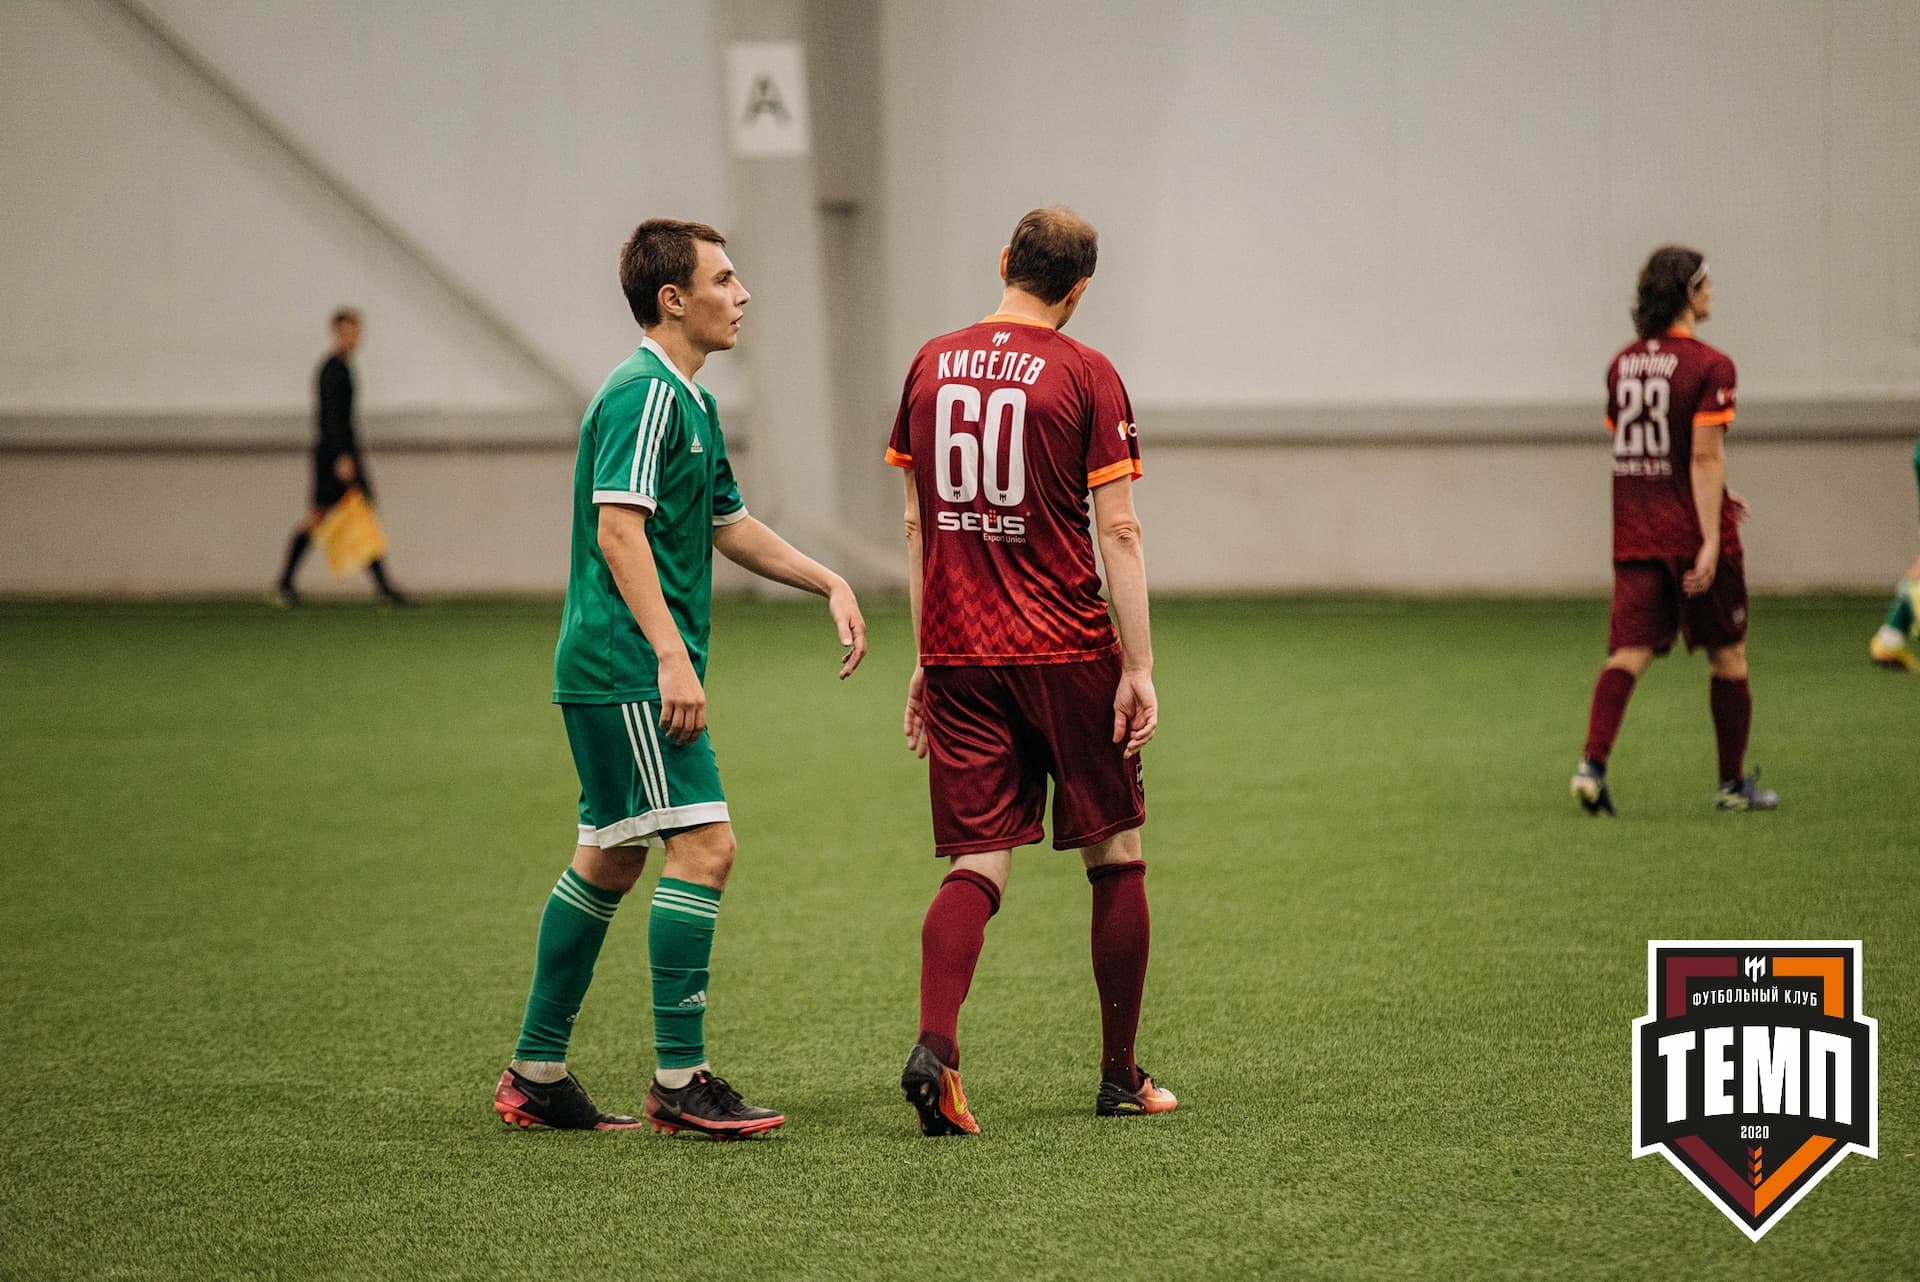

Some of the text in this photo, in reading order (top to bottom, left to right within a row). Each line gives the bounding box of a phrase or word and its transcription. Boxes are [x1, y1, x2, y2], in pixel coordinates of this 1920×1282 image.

[937, 349, 1046, 385] КИСЕЛЕВ
[936, 384, 1027, 507] 60
[1614, 377, 1671, 458] 23
[983, 533, 1026, 544] Export Union
